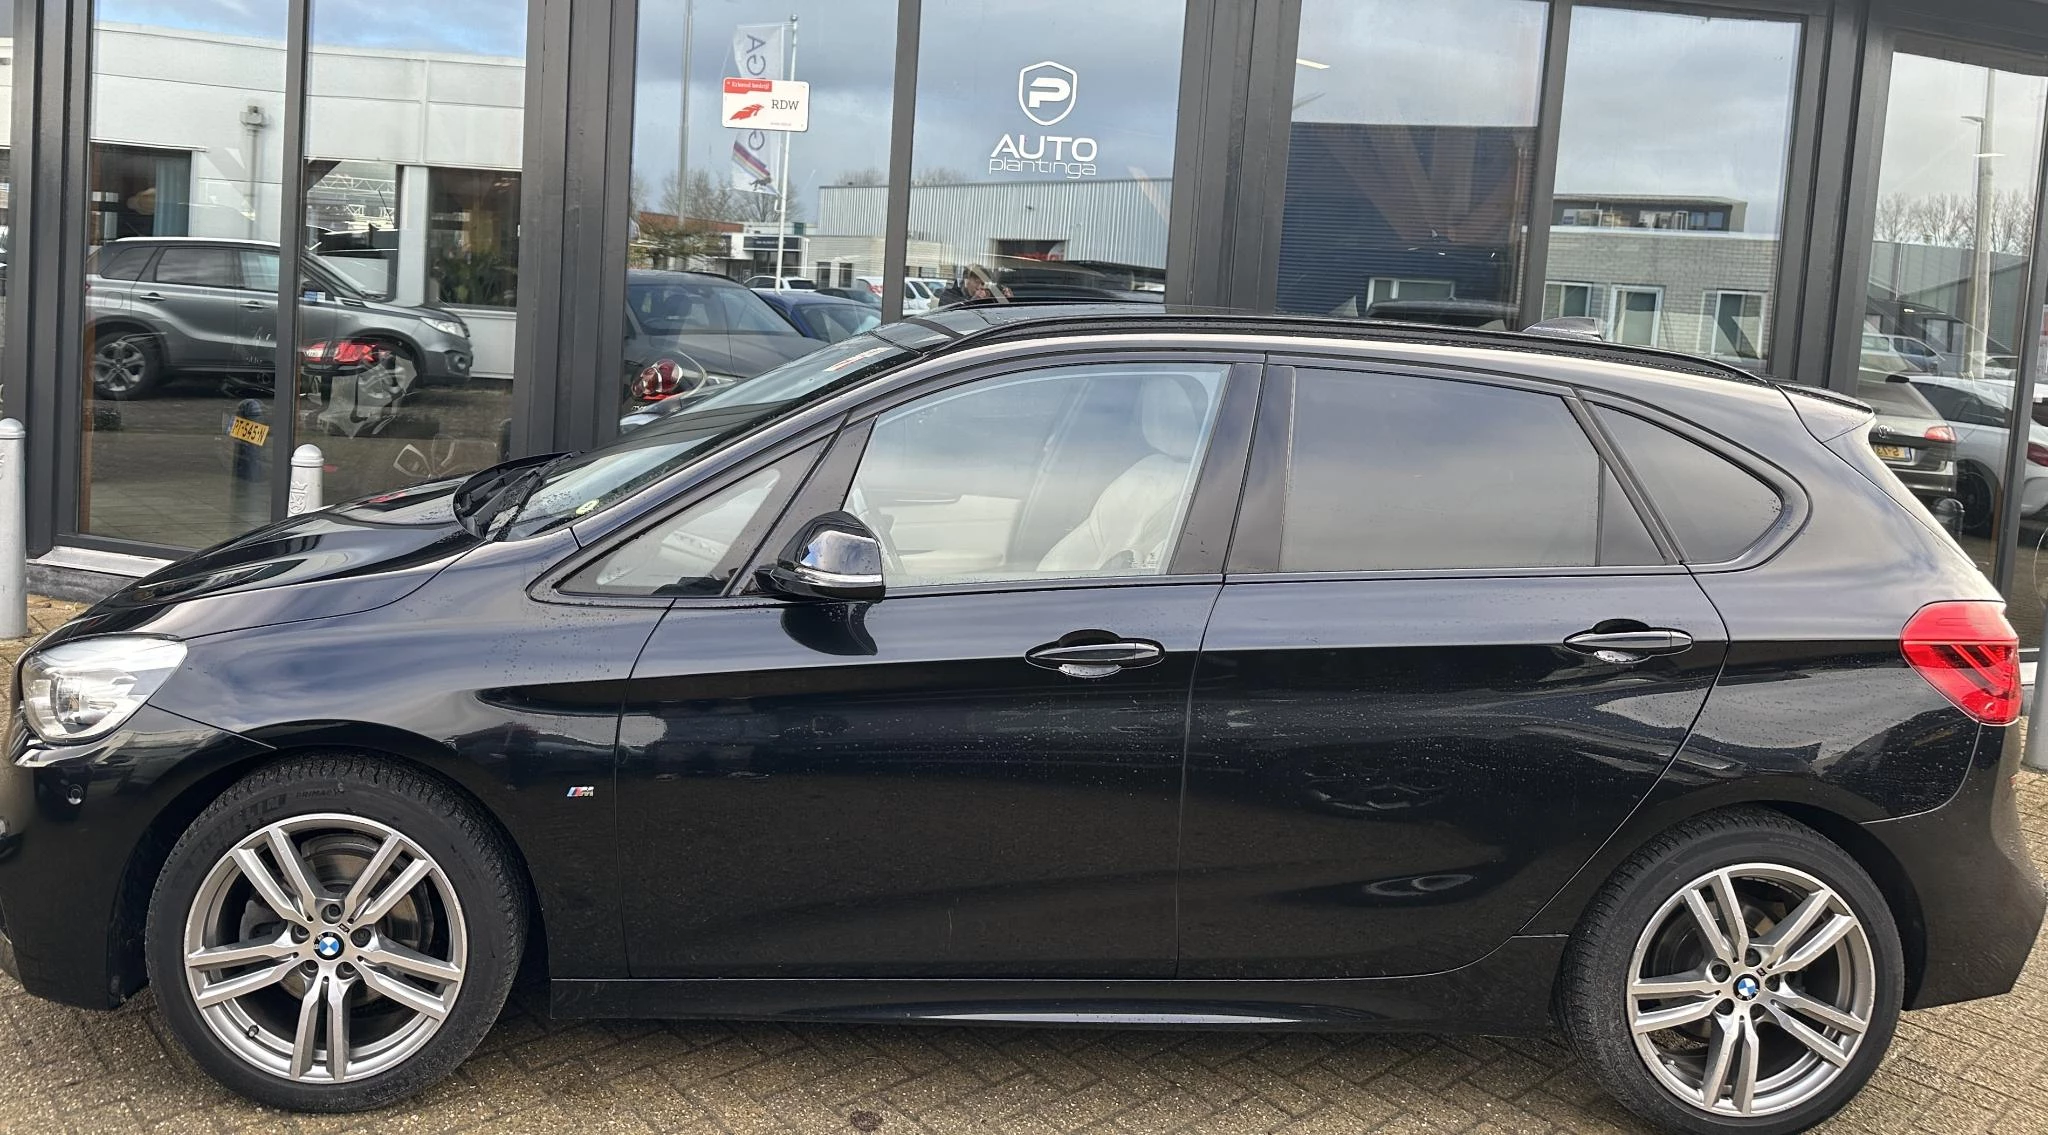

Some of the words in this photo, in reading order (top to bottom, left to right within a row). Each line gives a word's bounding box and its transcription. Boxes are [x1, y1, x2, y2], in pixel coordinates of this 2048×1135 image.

[771, 99, 800, 111] RDW
[990, 133, 1098, 162] AUTO
[988, 156, 1097, 180] plantinga
